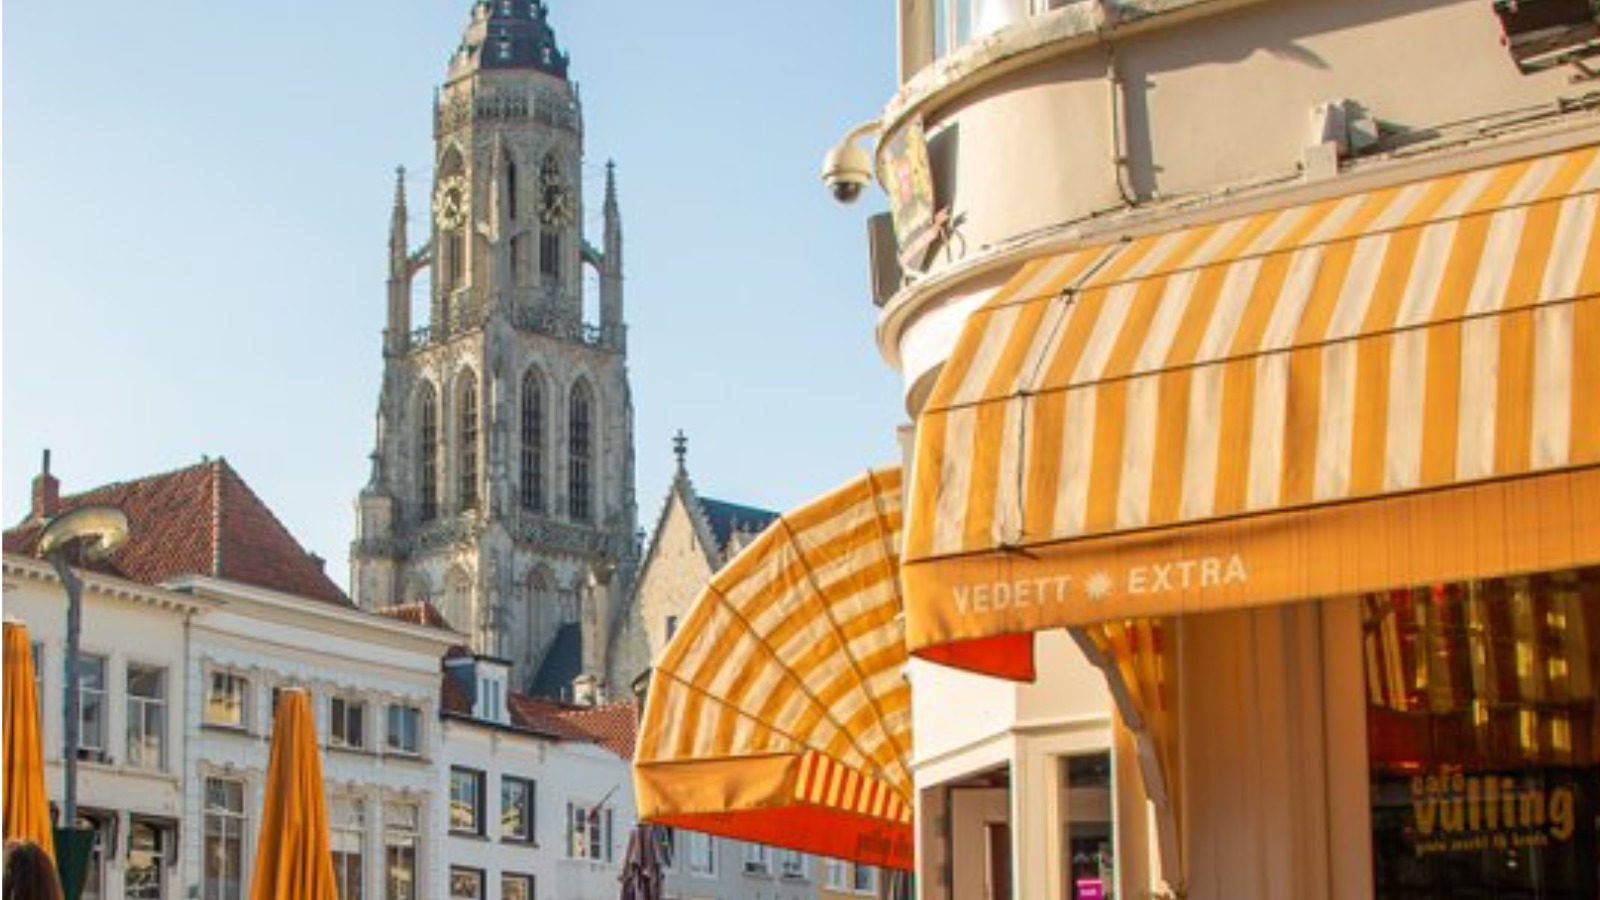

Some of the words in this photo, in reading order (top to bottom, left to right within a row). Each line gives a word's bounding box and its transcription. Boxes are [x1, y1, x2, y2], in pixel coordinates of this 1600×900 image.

[953, 573, 1071, 614] VEDETT
[1127, 554, 1248, 595] EXTRA
[1413, 775, 1574, 841] vulling
